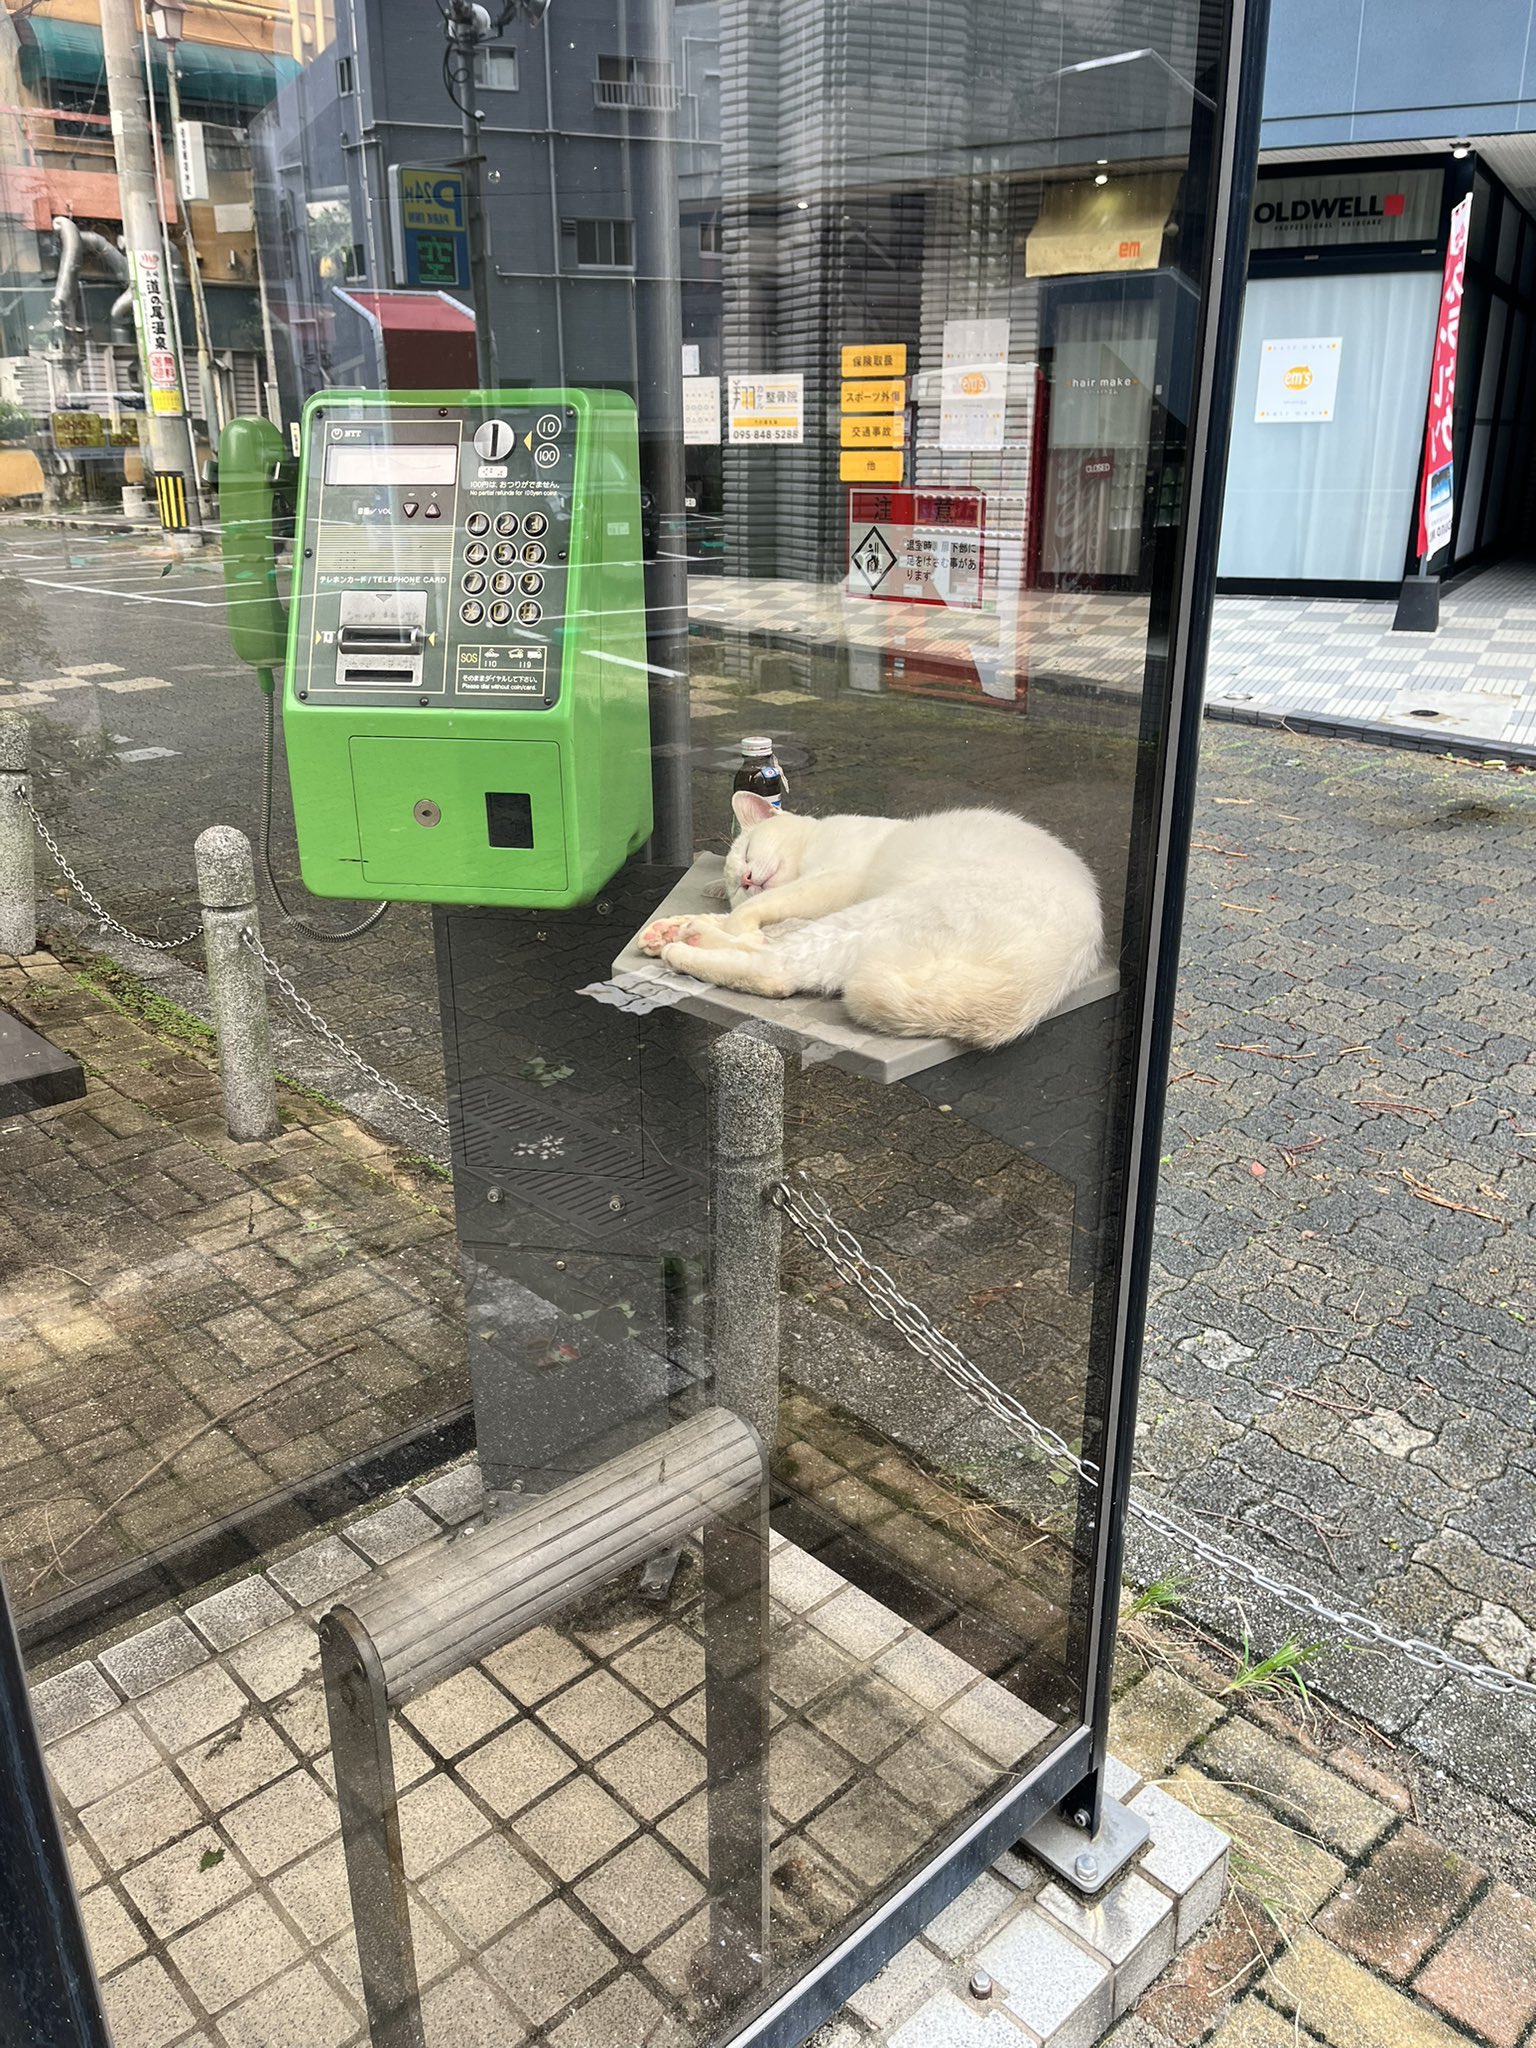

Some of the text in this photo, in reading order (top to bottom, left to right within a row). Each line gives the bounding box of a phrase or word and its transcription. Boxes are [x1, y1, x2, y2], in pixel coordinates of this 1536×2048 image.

[1254, 195, 1384, 224] OLDWELL
[1119, 241, 1141, 258] em
[147, 279, 168, 350] 道の尾温泉
[852, 355, 894, 368] 保険取扱
[1072, 376, 1131, 388] hair make
[542, 421, 556, 433] 10
[852, 426, 892, 438] 交通事故
[344, 430, 362, 438] NTT
[539, 450, 556, 462] 100
[1085, 463, 1111, 473] CLOSED
[422, 576, 447, 584] CARD
[460, 652, 478, 663] SOS
[484, 660, 497, 668] 110
[519, 661, 532, 669] 119
